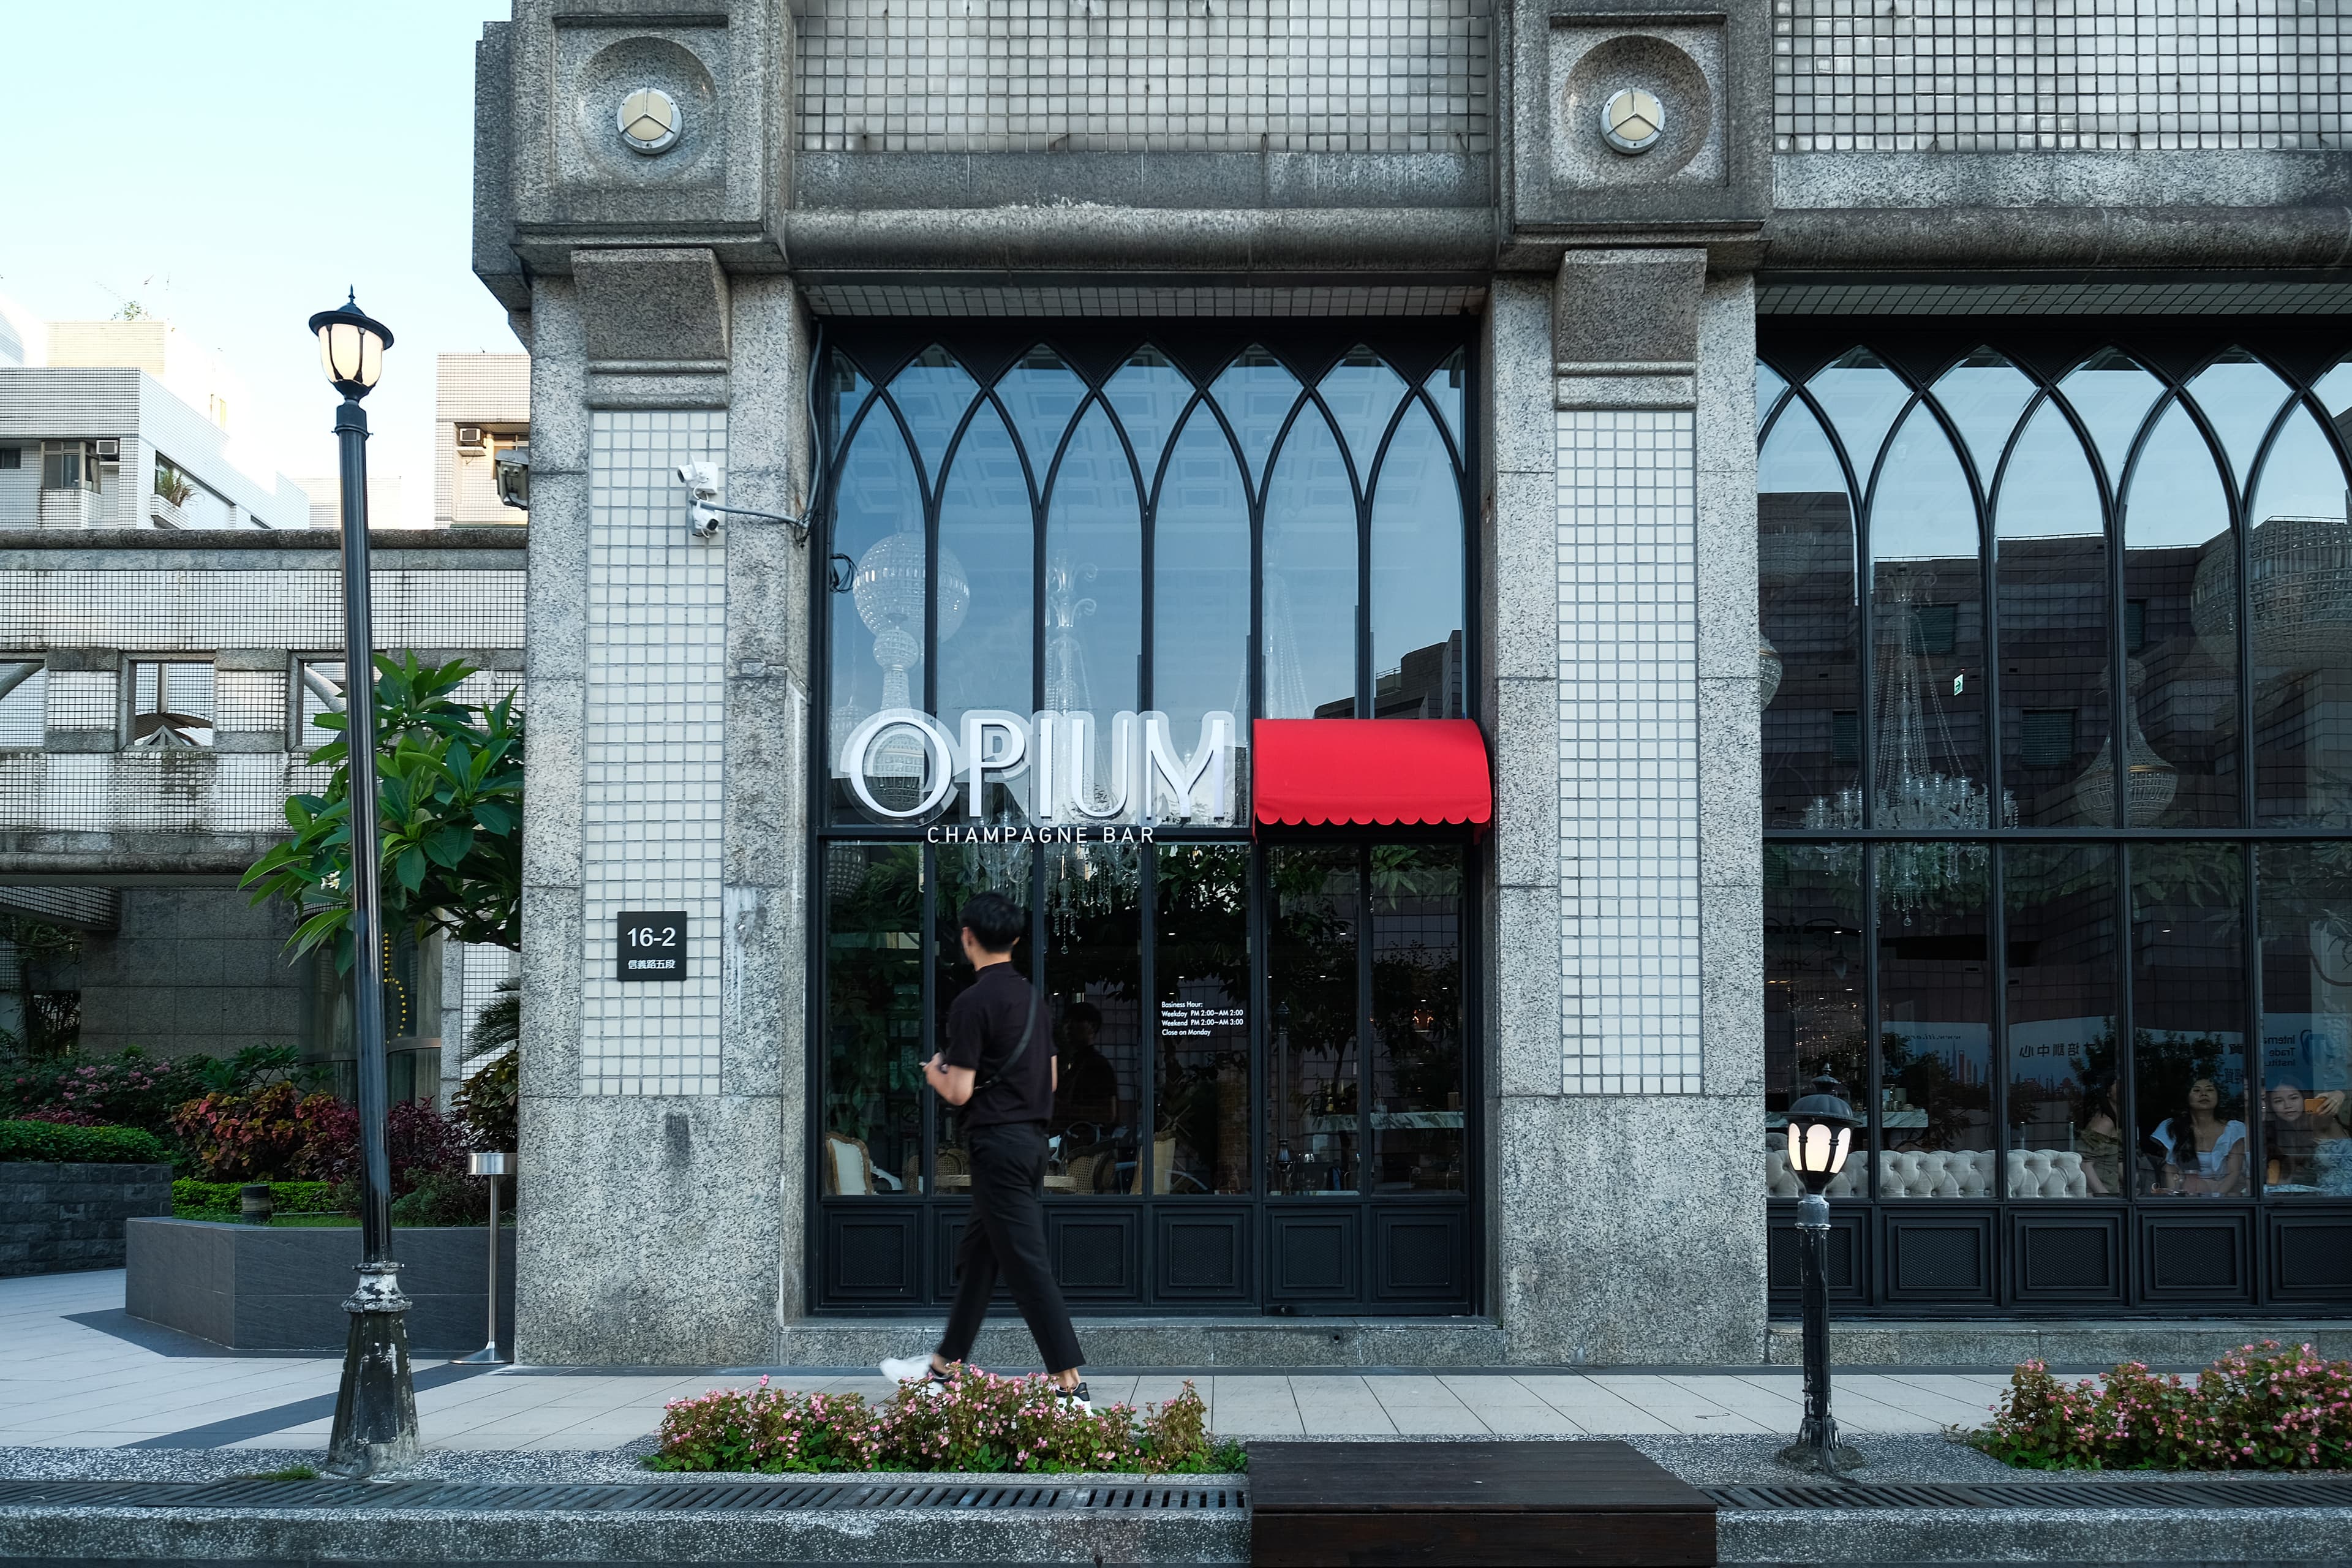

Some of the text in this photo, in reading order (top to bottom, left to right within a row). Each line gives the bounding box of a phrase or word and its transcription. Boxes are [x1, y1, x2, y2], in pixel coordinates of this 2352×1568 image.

[849, 716, 1224, 818] OPIUM
[927, 826, 1155, 843] CHAMPAGNE BAR
[627, 927, 676, 947] 16-2
[628, 959, 676, 970] 信義路五段
